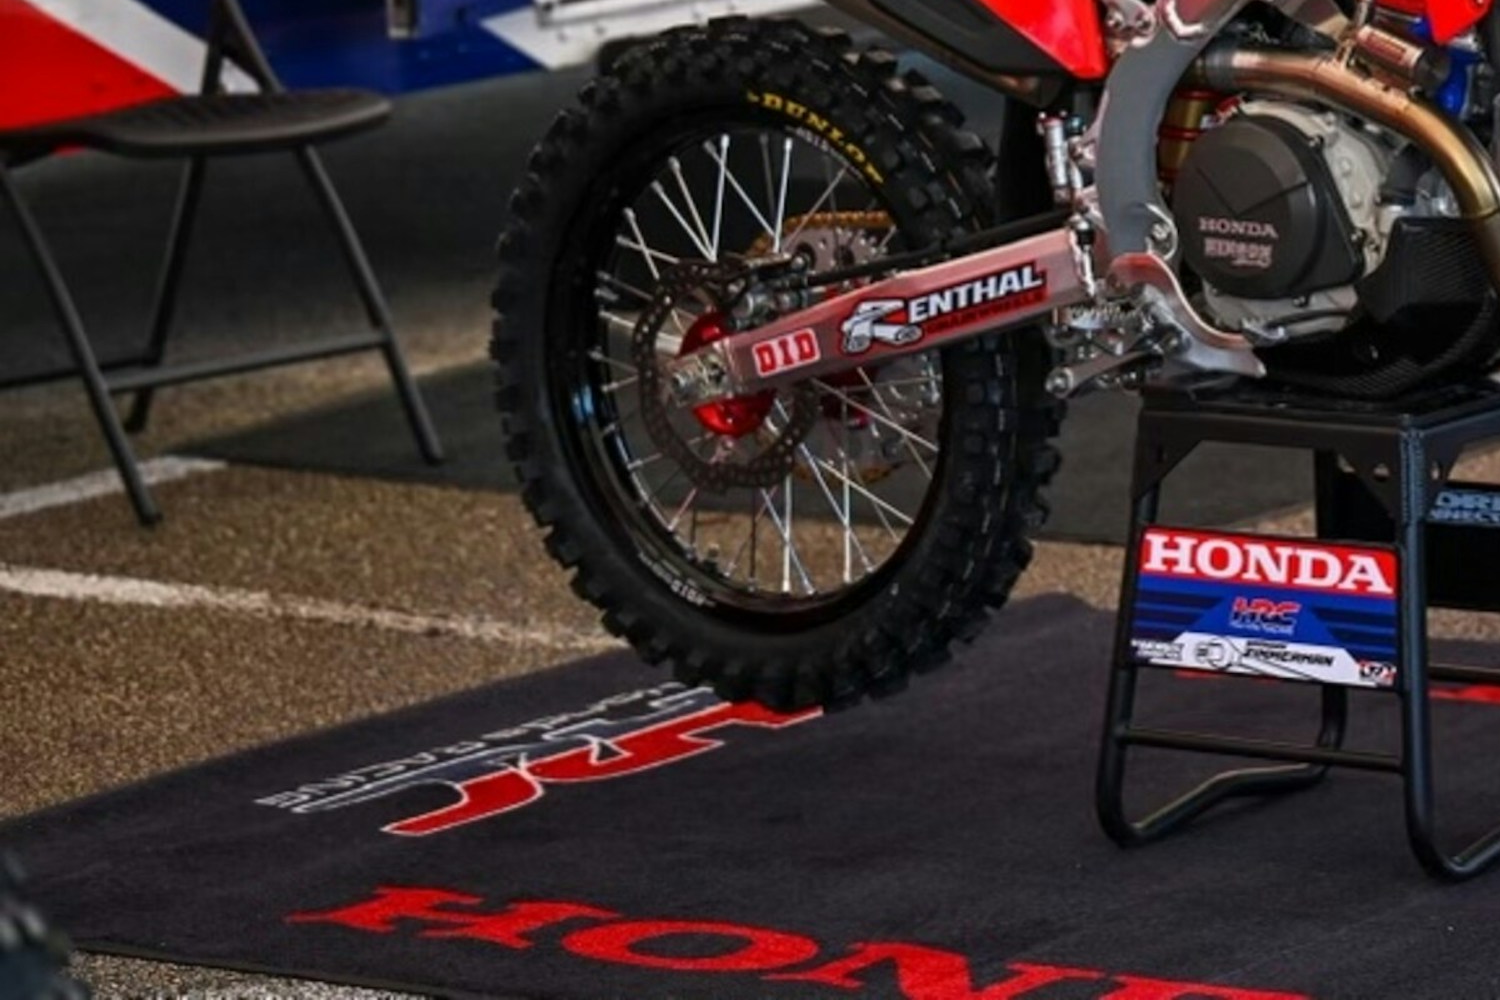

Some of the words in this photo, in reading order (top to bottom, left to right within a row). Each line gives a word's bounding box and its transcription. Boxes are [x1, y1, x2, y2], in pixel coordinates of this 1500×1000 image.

[760, 92, 885, 184] DUNLOP
[1198, 216, 1279, 239] HONDA
[1143, 533, 1394, 595] HONDA
